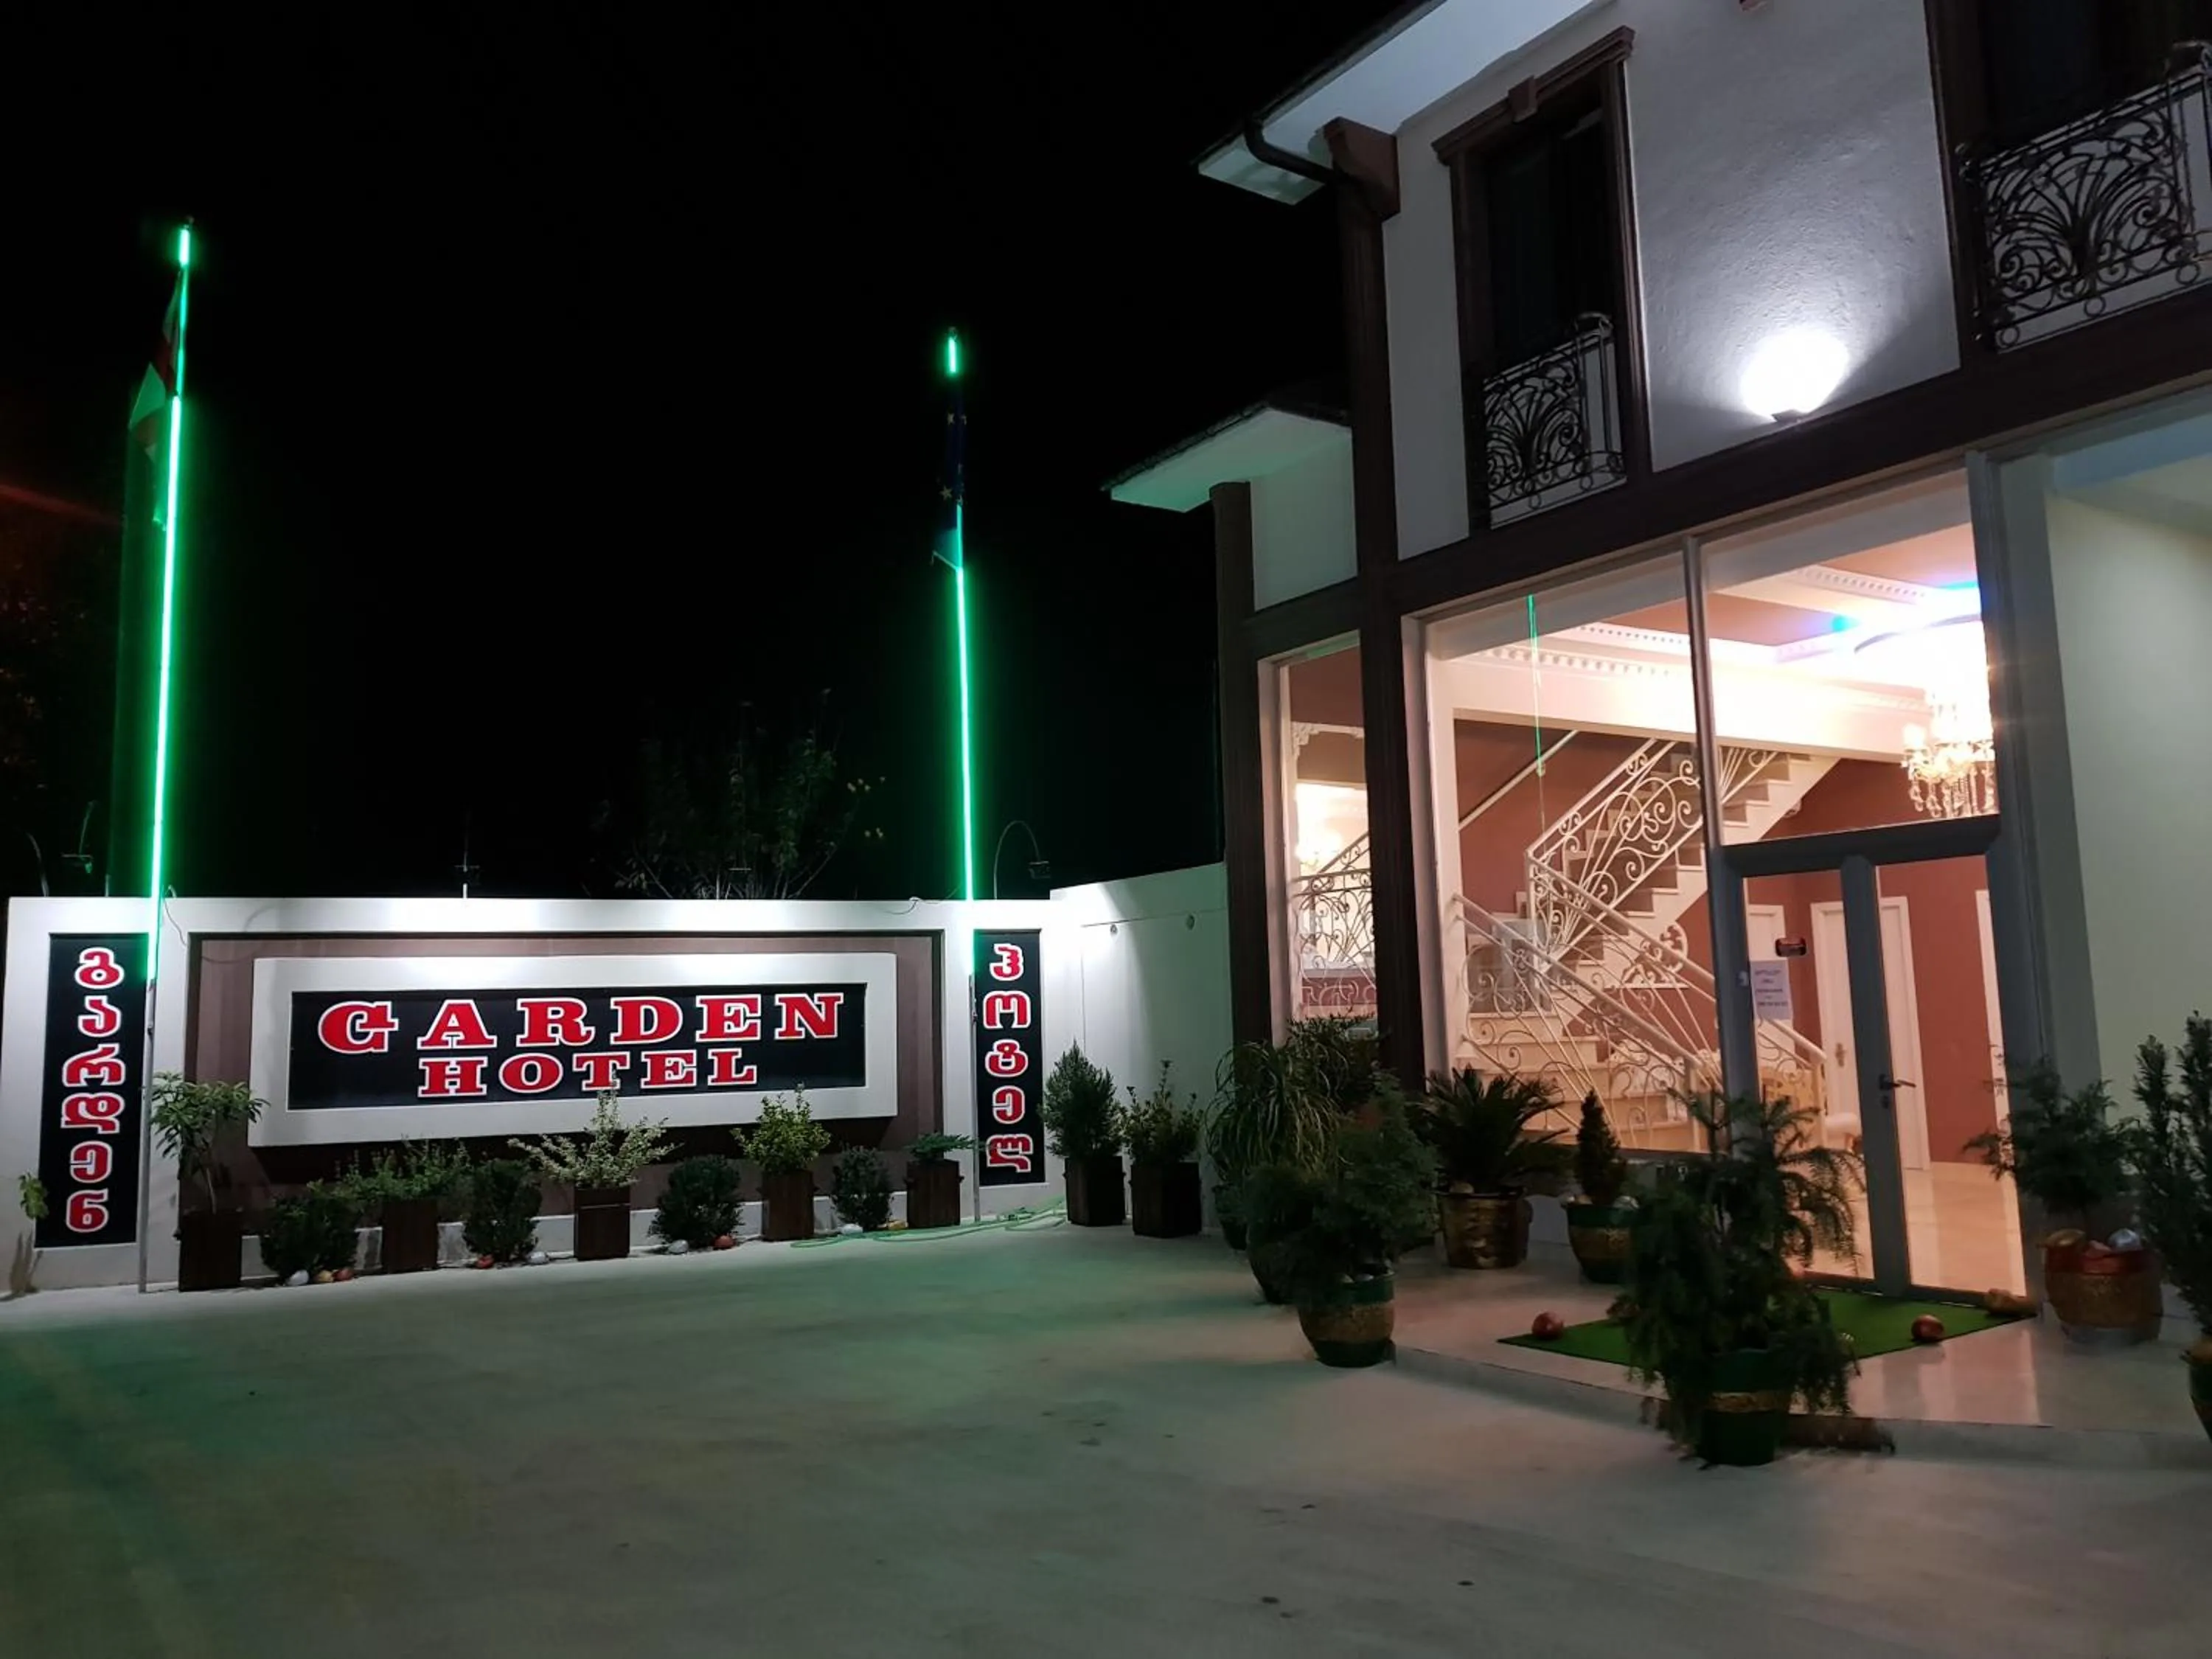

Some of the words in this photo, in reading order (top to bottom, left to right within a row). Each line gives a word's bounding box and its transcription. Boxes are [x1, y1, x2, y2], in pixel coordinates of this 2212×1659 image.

[62, 947, 125, 1232] გარდენ
[318, 992, 844, 1054] GARDEN
[417, 1048, 757, 1097] HOTEL
[983, 943, 1032, 1172] ჰოტელ
